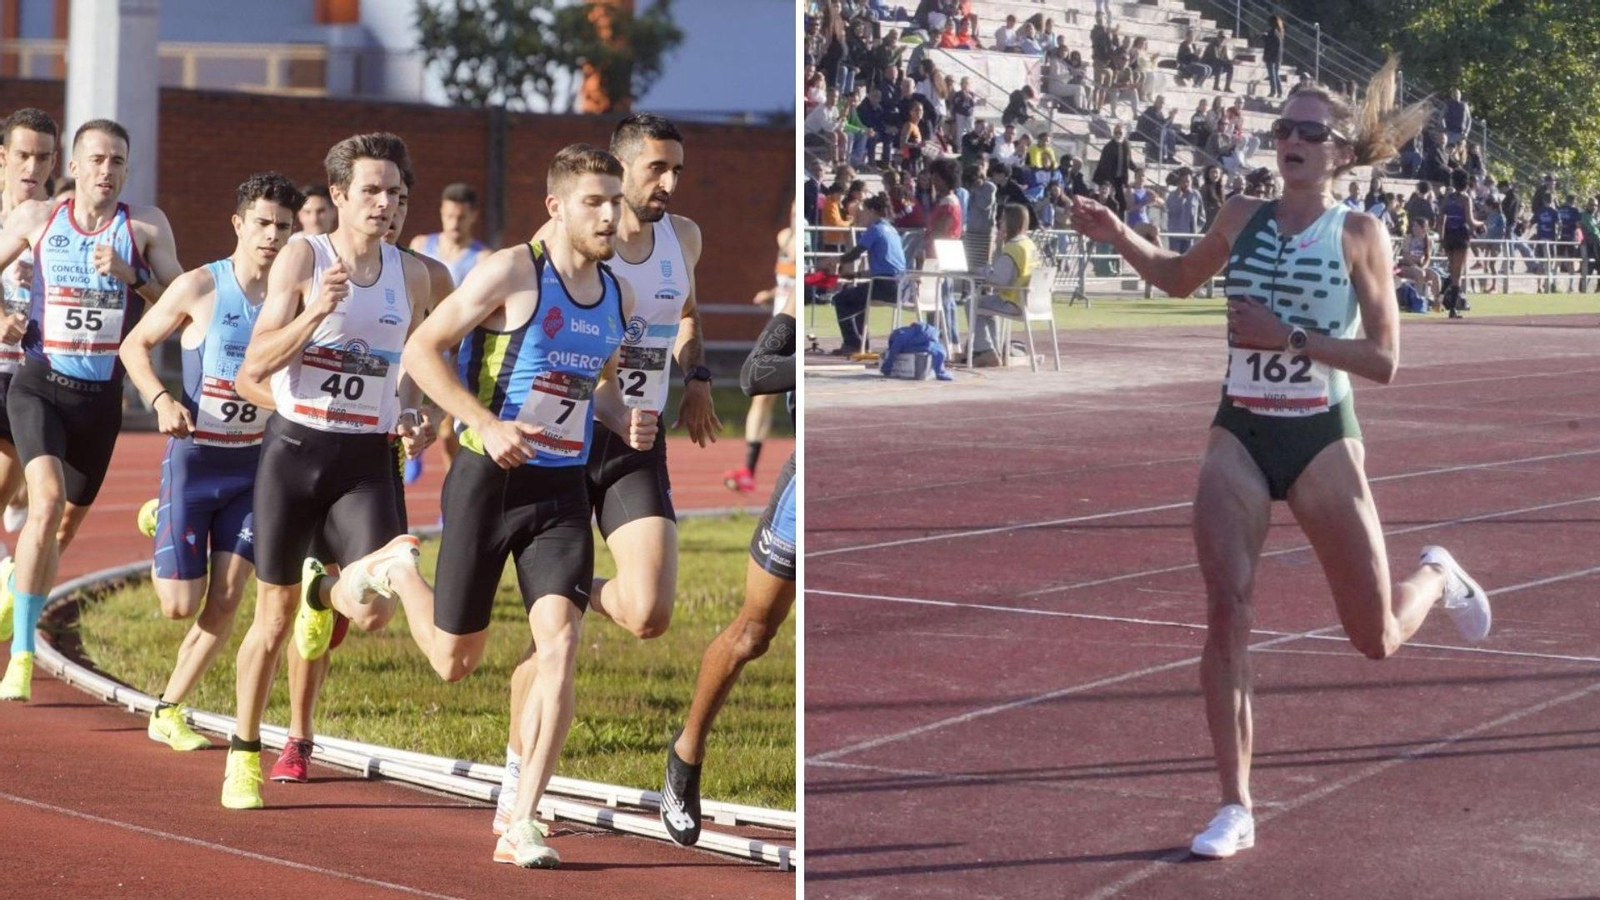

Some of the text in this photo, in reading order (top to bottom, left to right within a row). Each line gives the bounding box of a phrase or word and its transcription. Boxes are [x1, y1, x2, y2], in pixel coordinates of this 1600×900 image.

[51, 264, 96, 275] CONCELLO
[56, 274, 91, 284] DE VIGO
[64, 308, 103, 331] 55
[223, 344, 247, 352] CONCE
[1245, 352, 1312, 384] 162
[320, 373, 365, 401] 40
[220, 401, 258, 423] 98
[554, 398, 576, 425] 7
